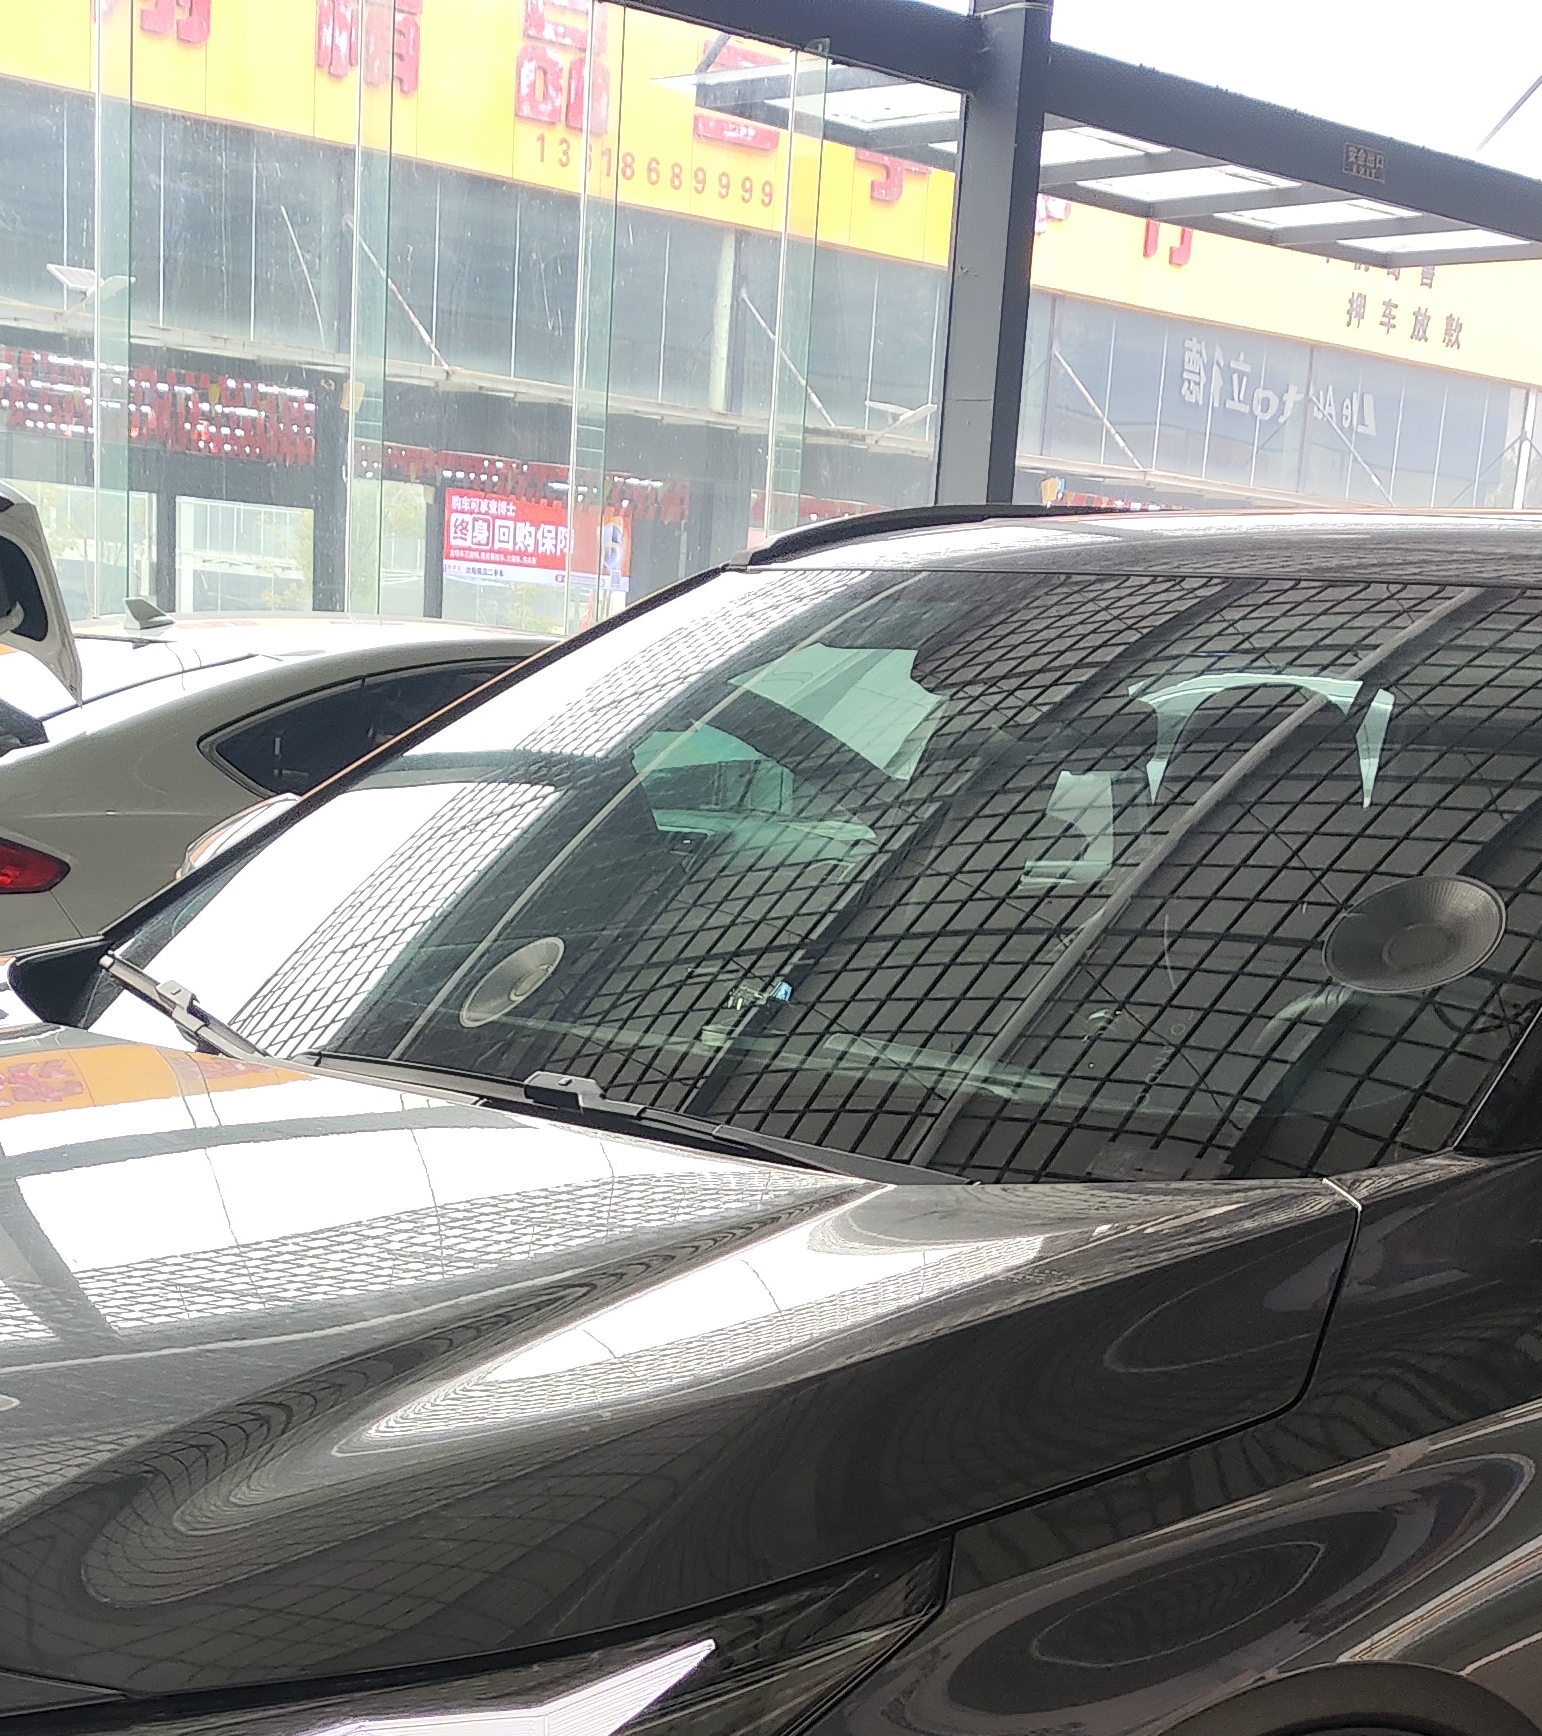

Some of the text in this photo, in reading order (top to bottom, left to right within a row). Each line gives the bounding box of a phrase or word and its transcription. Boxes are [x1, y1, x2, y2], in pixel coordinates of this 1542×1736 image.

[1348, 146, 1385, 169] 安全出口
[1346, 291, 1463, 350] 押车放款
